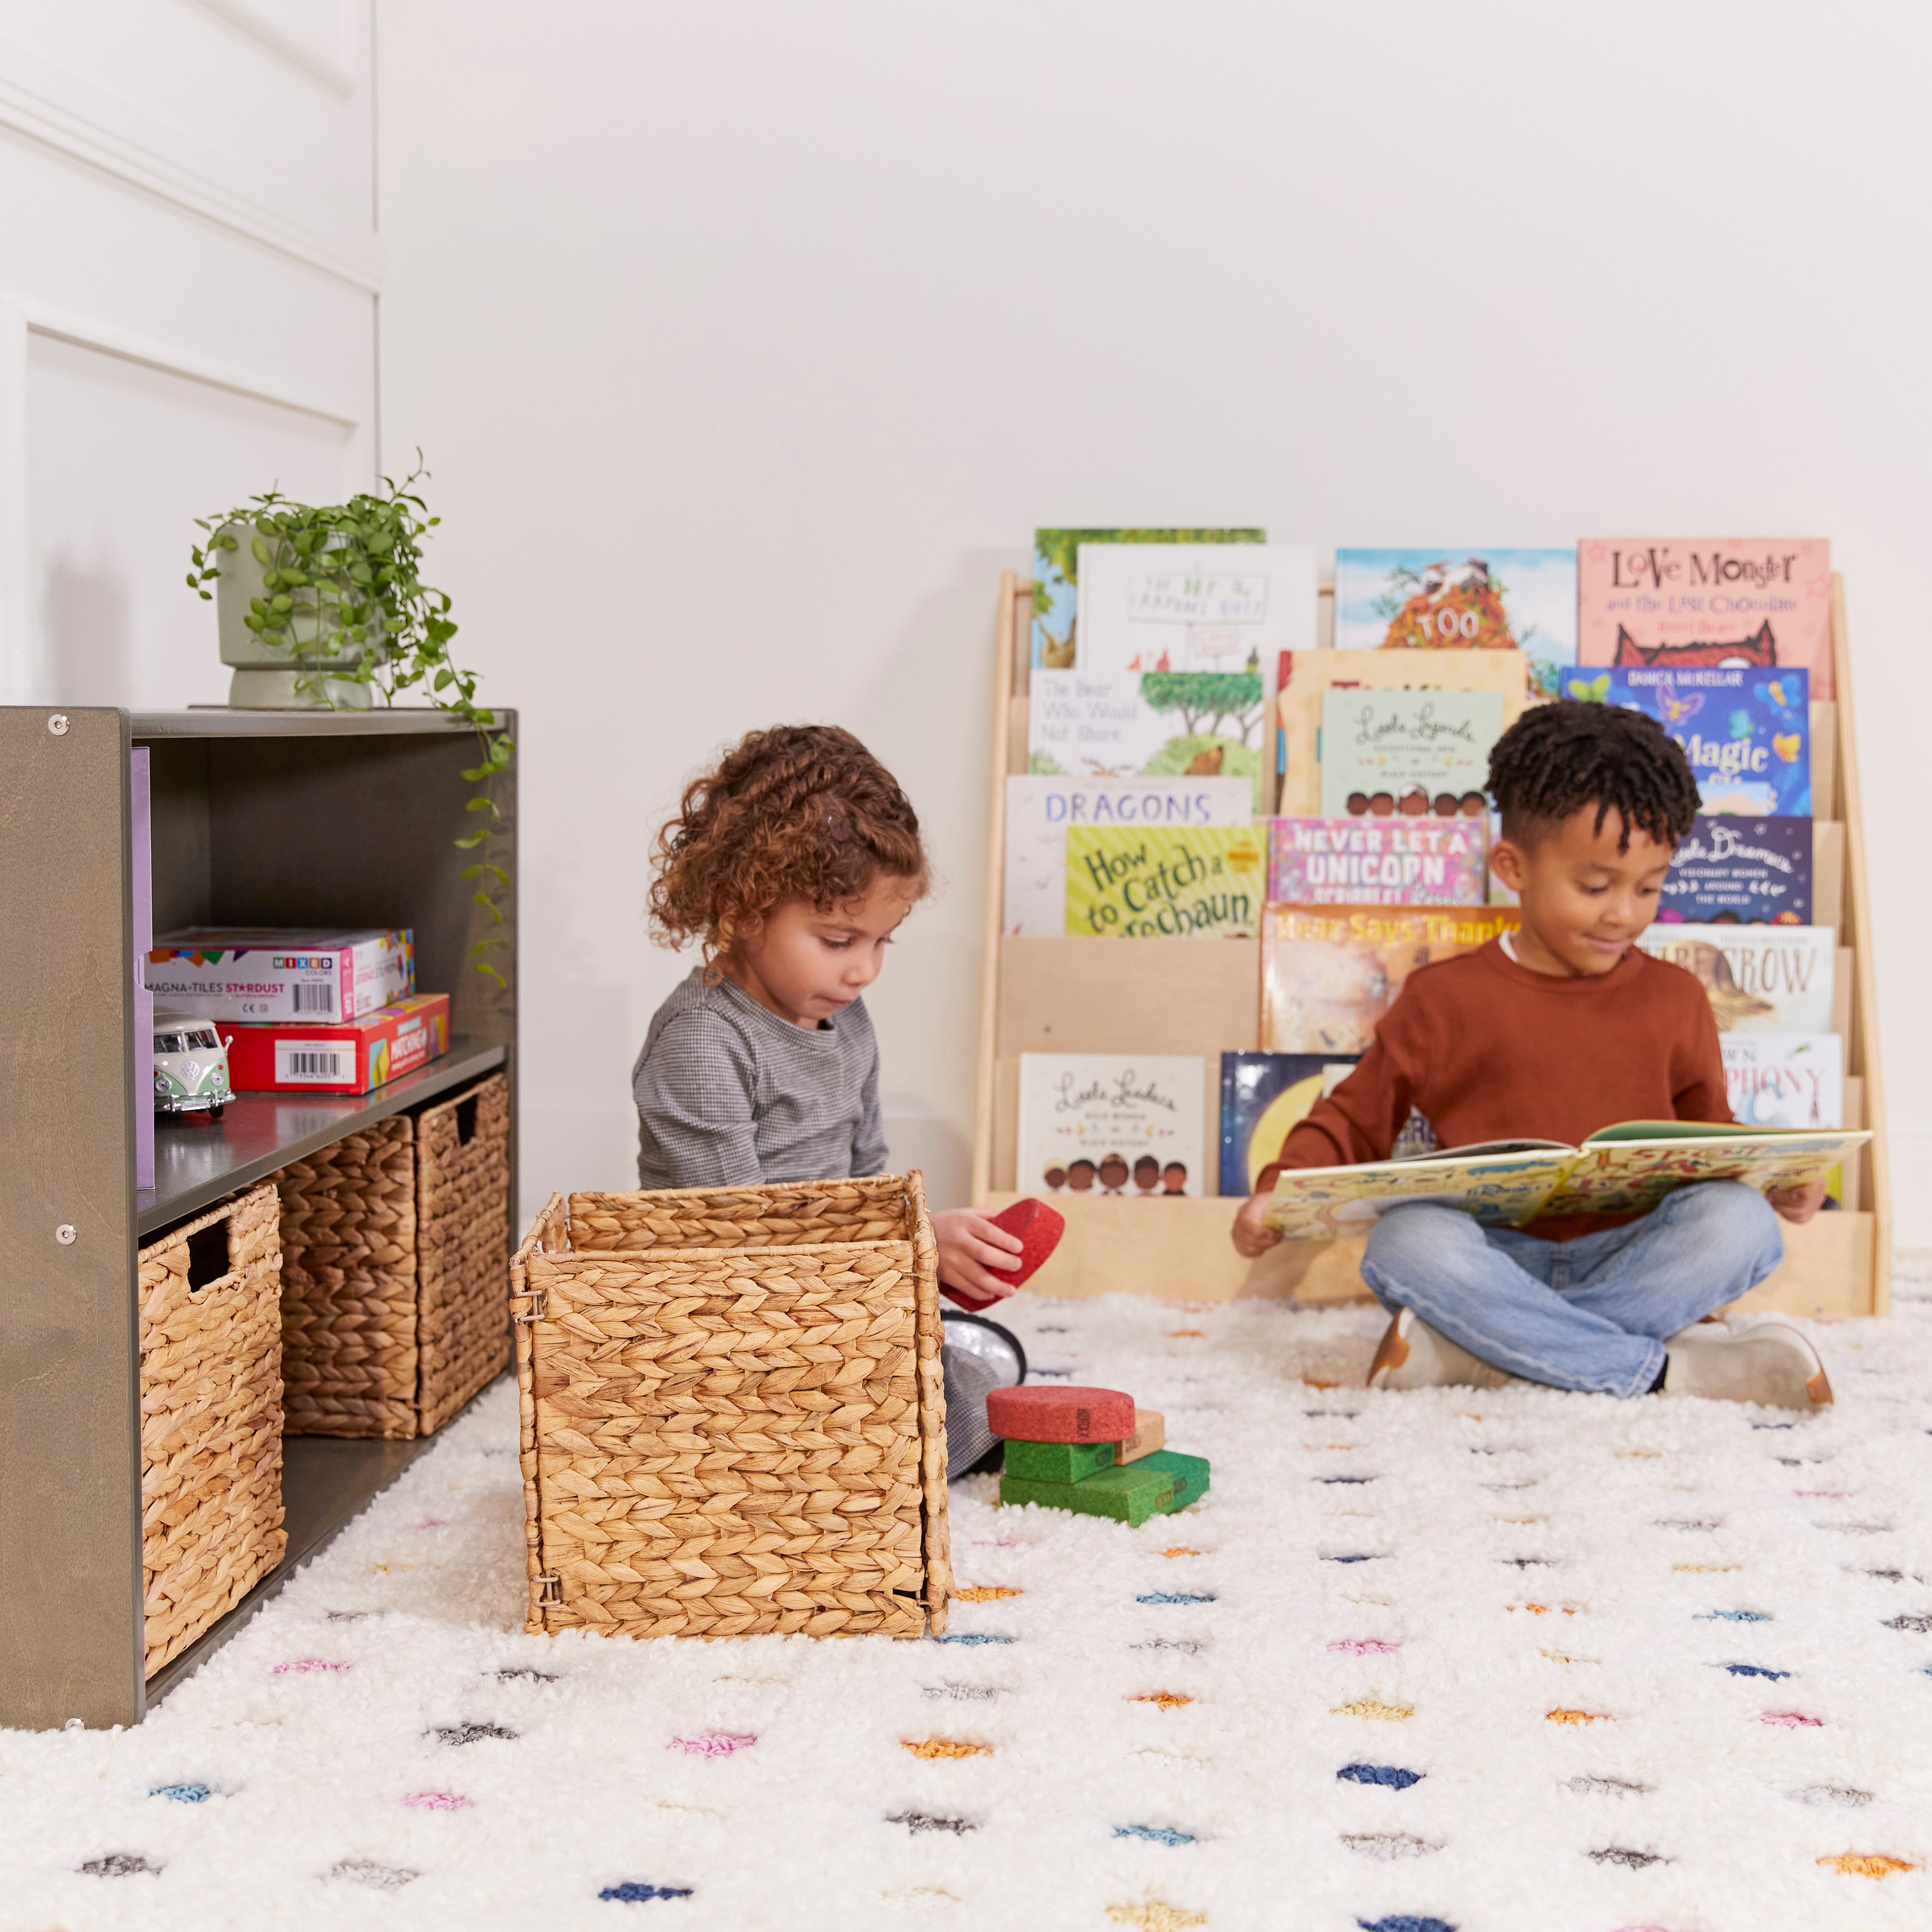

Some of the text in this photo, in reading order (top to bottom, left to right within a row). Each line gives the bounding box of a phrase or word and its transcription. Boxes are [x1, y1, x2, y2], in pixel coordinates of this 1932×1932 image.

[1690, 553, 1796, 589] Monster
[1416, 607, 1479, 639] TOO
[1042, 679, 1111, 698] The Bear
[1628, 670, 1674, 686] DANICA
[1674, 733, 1769, 775] Magic
[1046, 793, 1211, 824] DRAGONS
[1295, 830, 1467, 854] NEVER LET A
[1084, 843, 1146, 891] How
[1307, 854, 1446, 886] UNICORN
[1088, 845, 1222, 934] to Catch a
[1120, 894, 1250, 937] rechaun
[1278, 913, 1343, 941] Bear
[1349, 912, 1415, 949] Says
[273, 957, 332, 968] MIXED
[144, 982, 223, 993] MAGNA-TILES
[1723, 1067, 1825, 1097] PHONY
